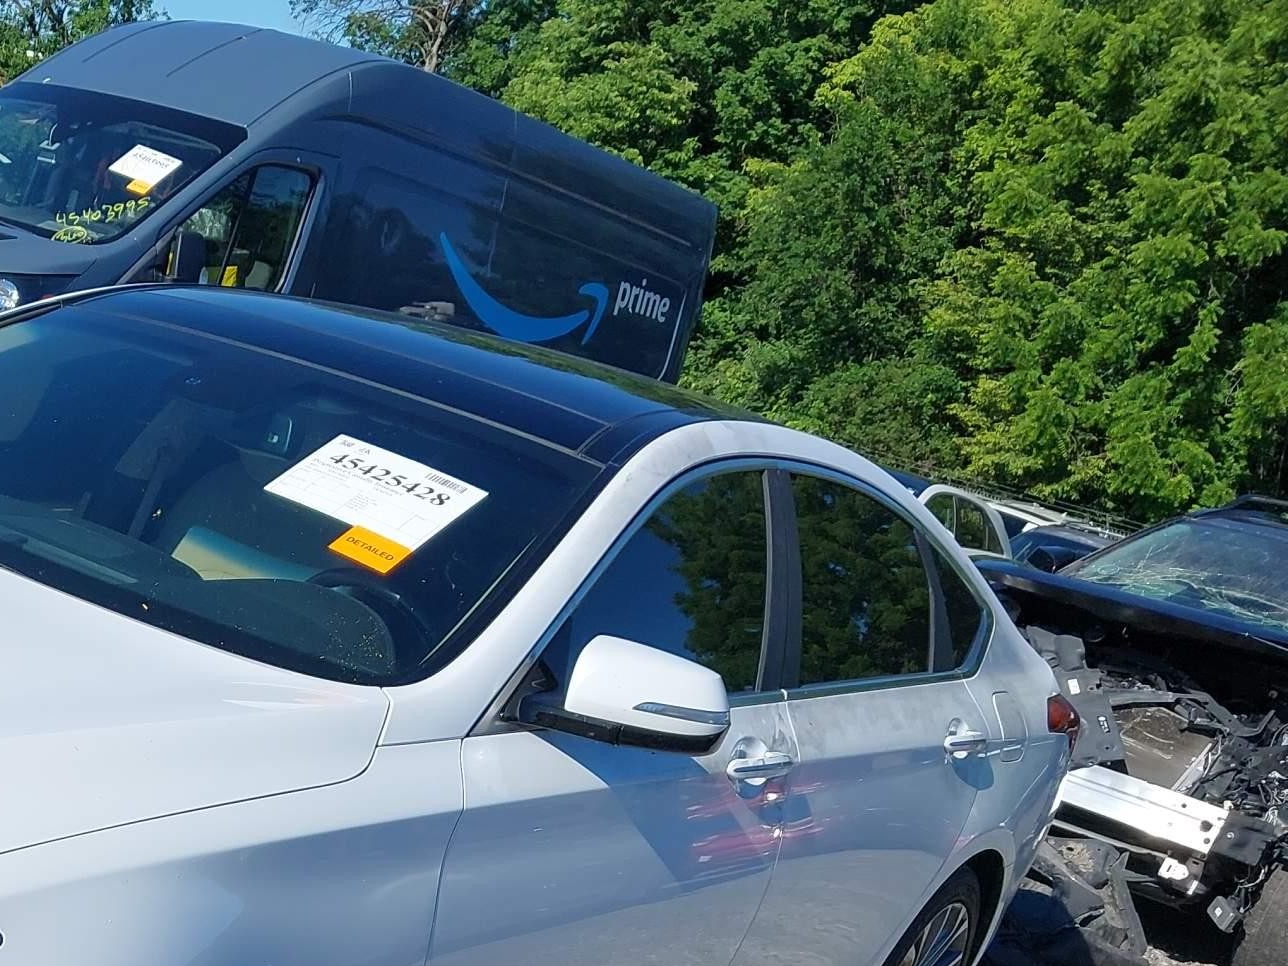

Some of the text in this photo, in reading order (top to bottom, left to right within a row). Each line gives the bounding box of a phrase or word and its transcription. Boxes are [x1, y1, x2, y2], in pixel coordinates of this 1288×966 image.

[612, 278, 671, 323] prime
[329, 454, 451, 506] 45425428
[345, 536, 395, 561] DETAILED
